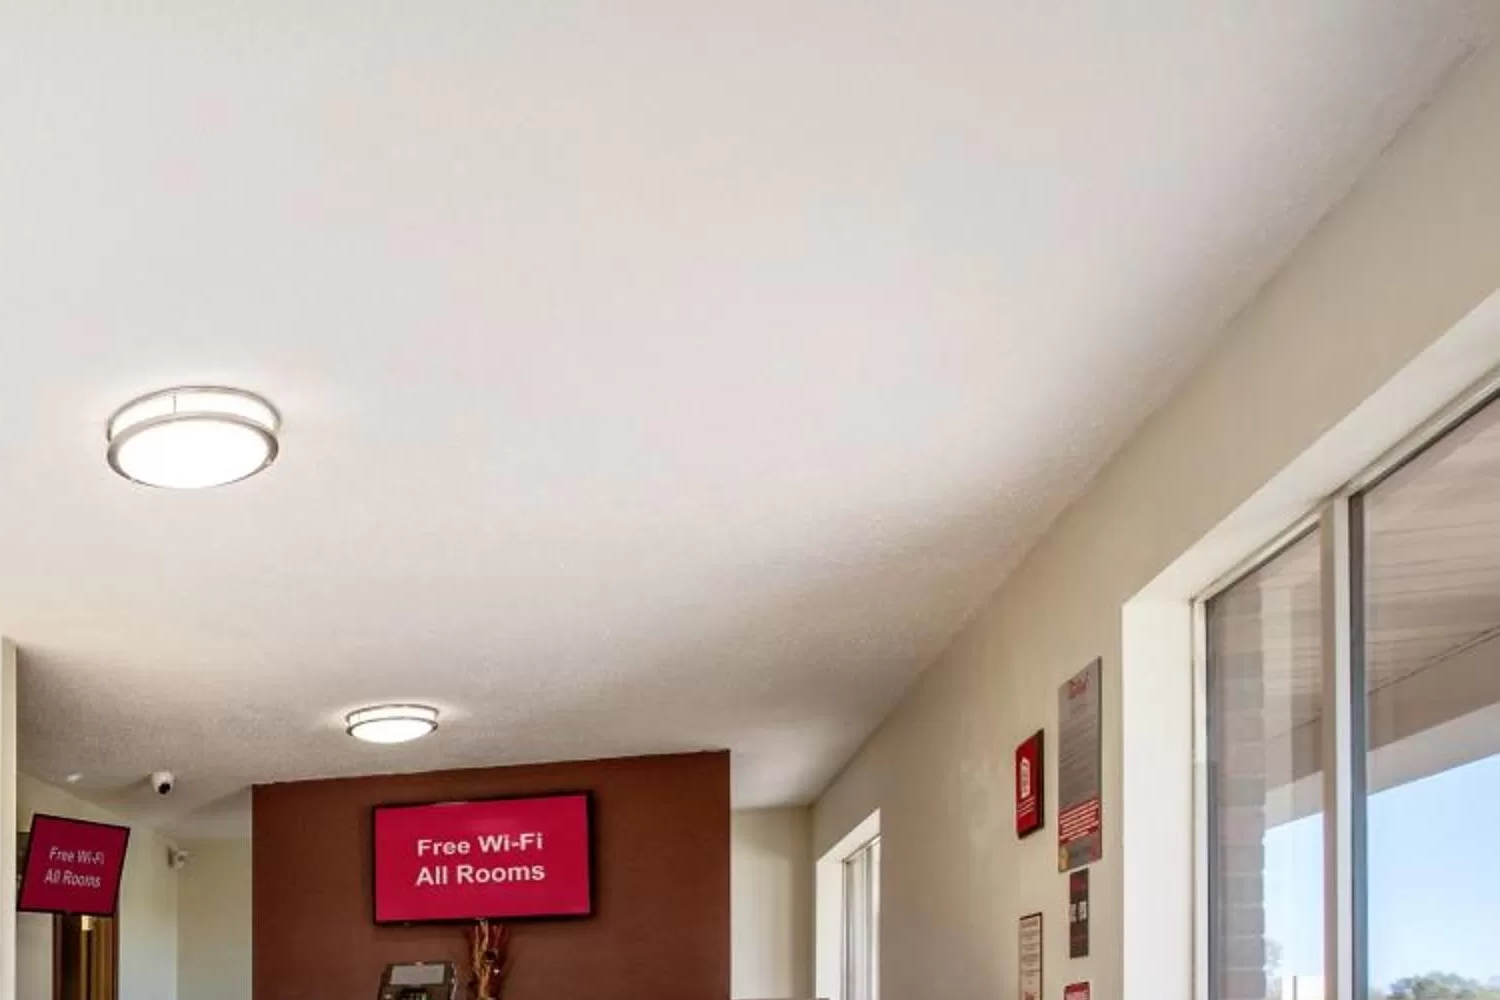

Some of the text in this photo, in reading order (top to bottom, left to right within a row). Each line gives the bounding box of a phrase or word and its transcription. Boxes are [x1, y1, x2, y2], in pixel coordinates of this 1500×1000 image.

[417, 832, 544, 856] Free Wi-Fi
[49, 846, 105, 865] Free Wi-Fi
[43, 868, 101, 888] All Rooms
[415, 864, 546, 886] All Rooms
